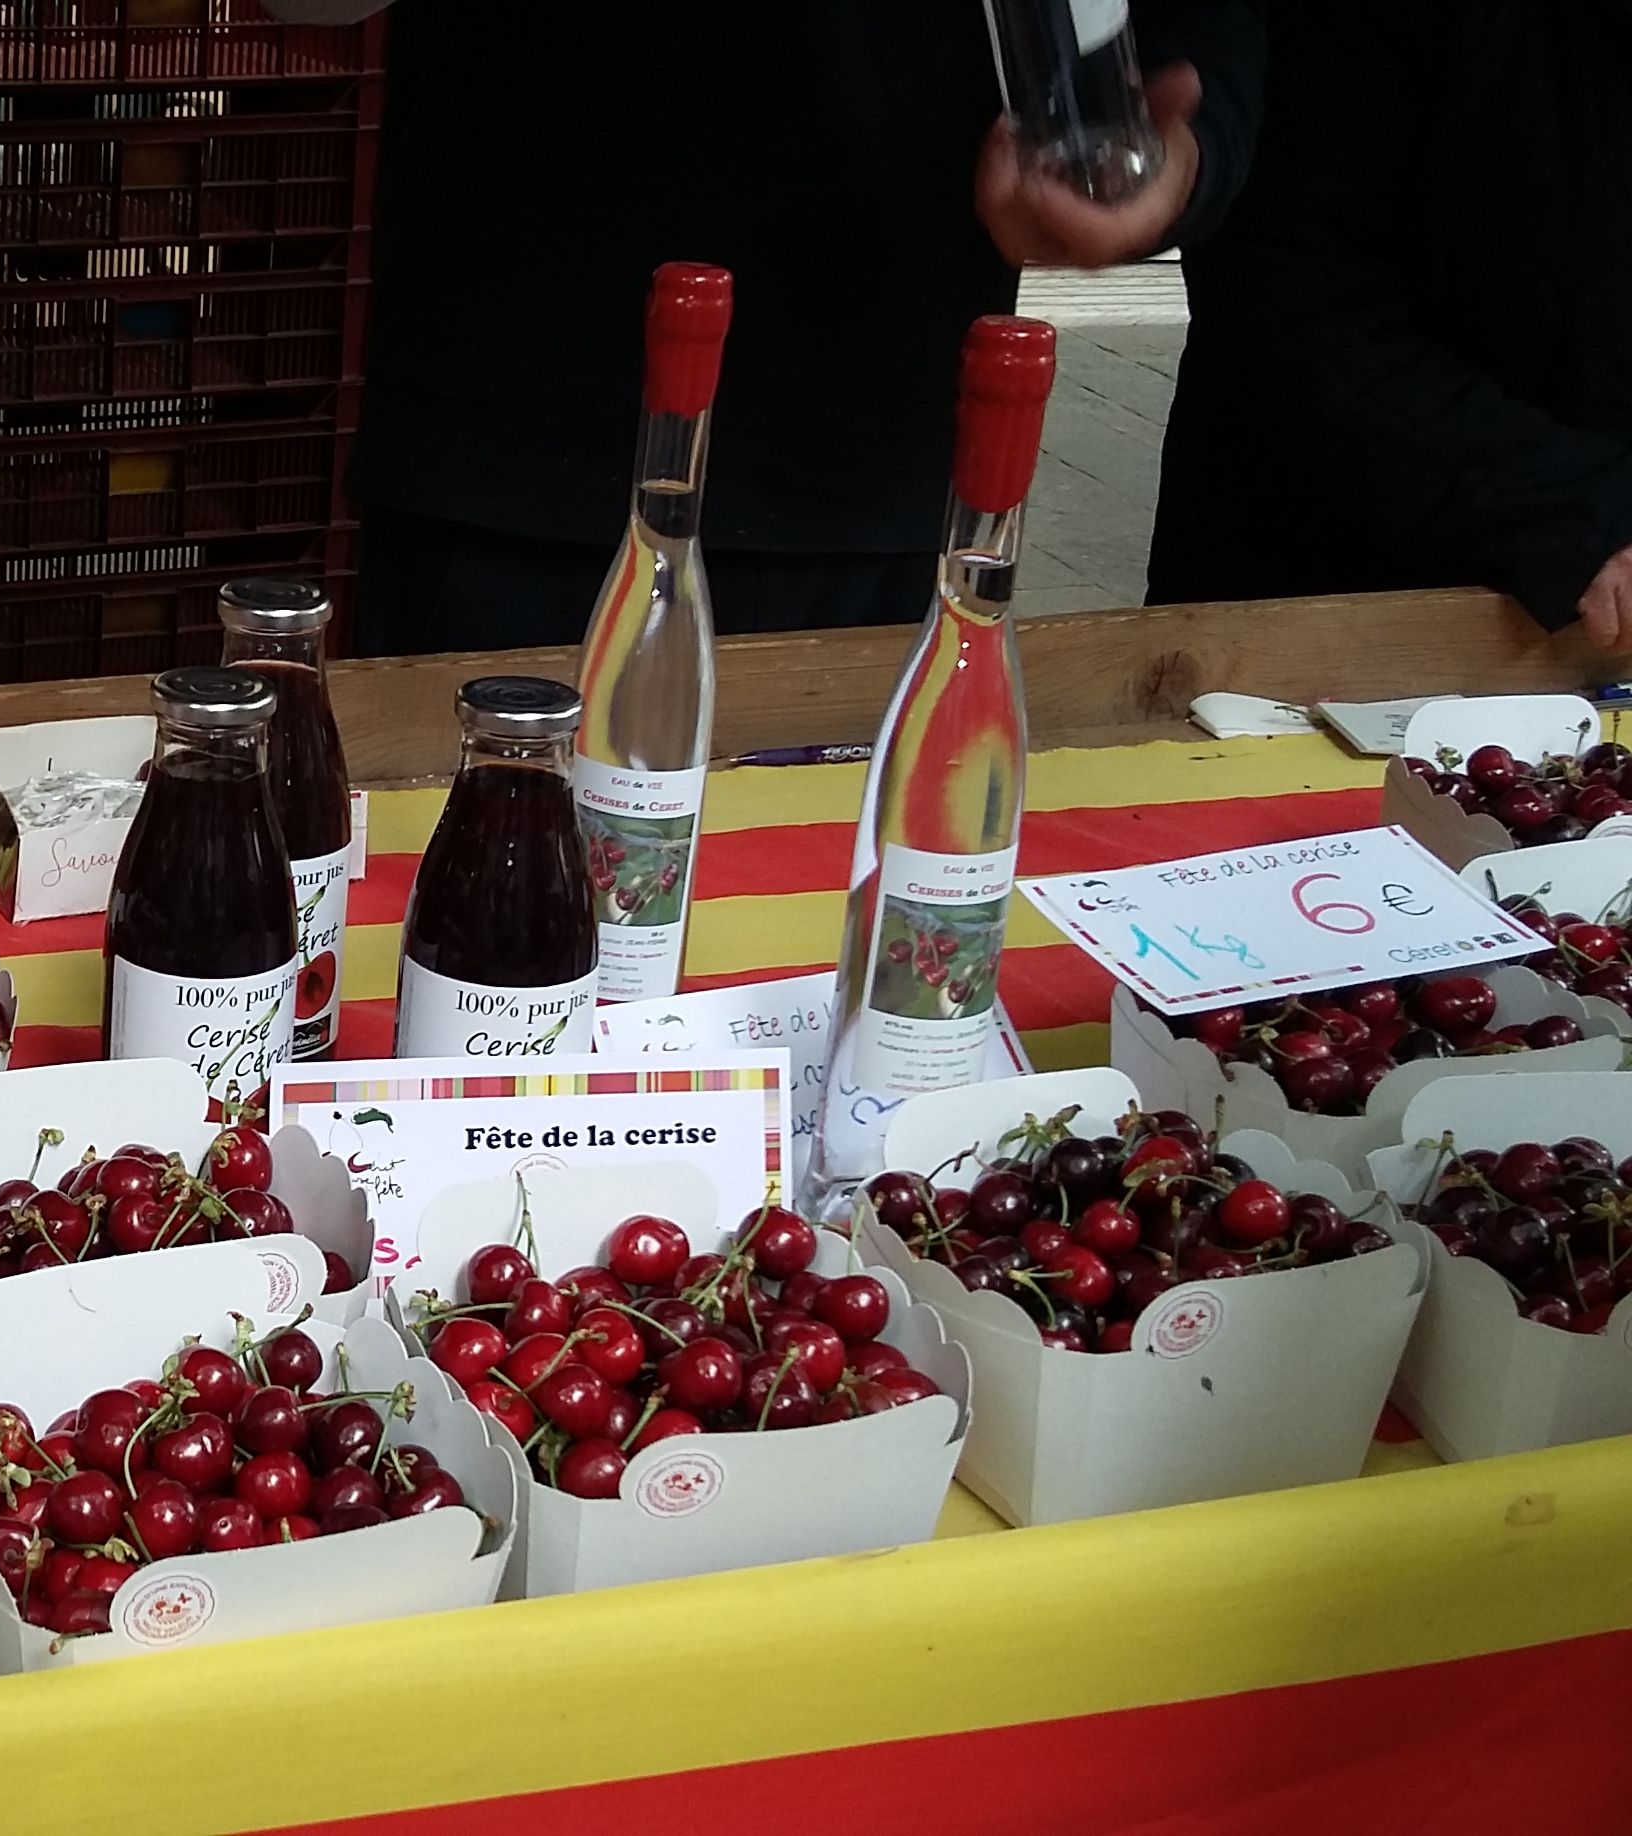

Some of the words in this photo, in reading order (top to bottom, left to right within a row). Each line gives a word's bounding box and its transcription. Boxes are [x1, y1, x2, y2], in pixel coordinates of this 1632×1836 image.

[1157, 866, 1217, 888] Fête
[1220, 860, 1253, 878] de
[1255, 854, 1282, 872] la
[1288, 840, 1360, 865] cerise
[1291, 873, 1376, 935] 6
[1381, 883, 1434, 916] €
[298, 922, 339, 953] éret
[175, 985, 238, 1009] 100%
[244, 984, 278, 1012] pur
[455, 989, 519, 1018] 100%
[526, 1000, 565, 1025] pur
[187, 1019, 271, 1048] Cerise
[729, 1013, 783, 1043] Fête
[790, 1006, 820, 1032] de
[235, 1035, 292, 1077] Céret
[465, 1031, 556, 1057] Cerise
[465, 1126, 533, 1150] Fête
[542, 1126, 578, 1148] de
[586, 1125, 616, 1146] la
[624, 1122, 717, 1146] cerise
